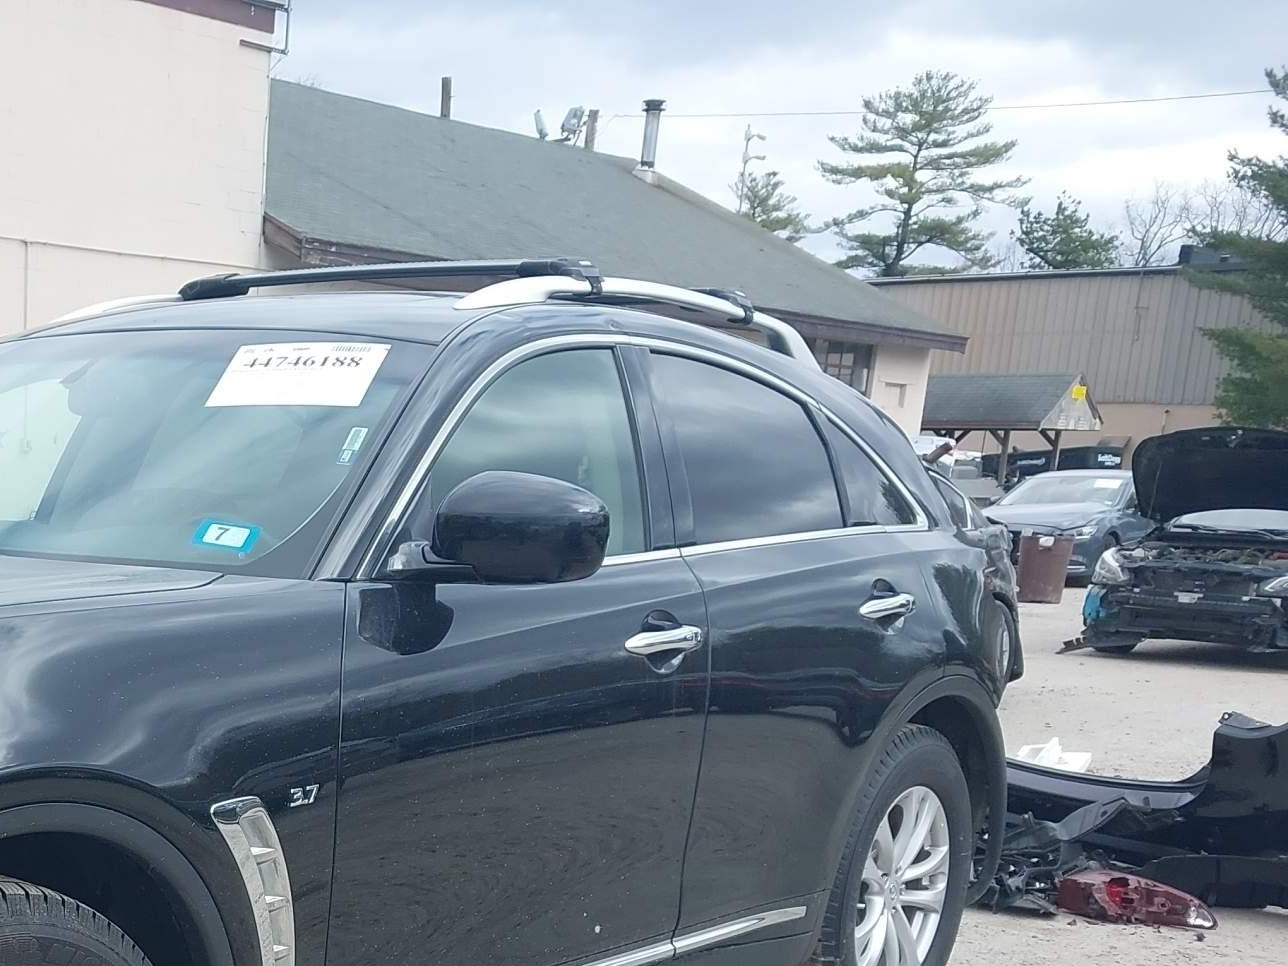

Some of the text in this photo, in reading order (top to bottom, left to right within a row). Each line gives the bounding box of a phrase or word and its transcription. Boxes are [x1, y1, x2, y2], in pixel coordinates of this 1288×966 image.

[243, 355, 363, 368] 44746188
[215, 526, 231, 541] 7
[290, 783, 320, 807] 3.7
